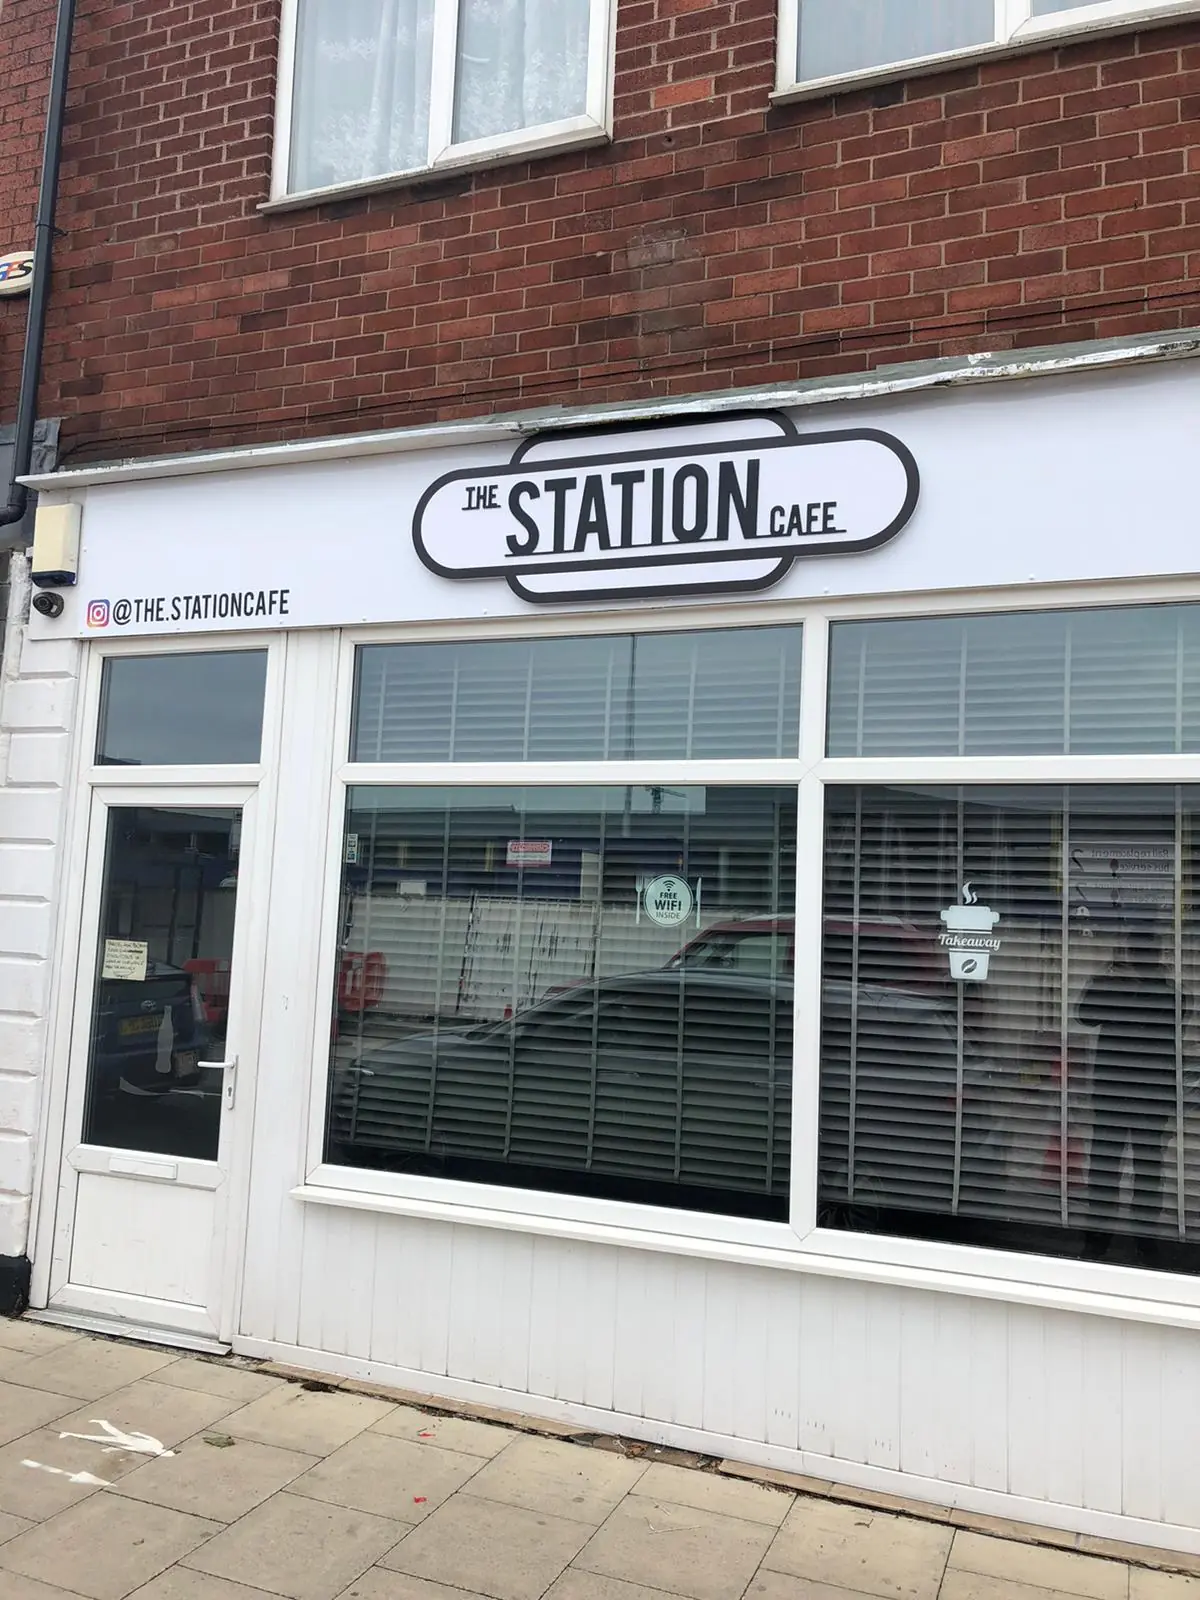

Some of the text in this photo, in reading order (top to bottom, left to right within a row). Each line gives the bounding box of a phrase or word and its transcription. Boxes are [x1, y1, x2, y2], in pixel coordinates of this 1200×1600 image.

[462, 458, 840, 557] THE STATION CAFE
[113, 589, 289, 624] @THE.STATIONCAFE
[660, 892, 678, 900] FREE
[655, 900, 682, 911] WIFI
[938, 934, 1001, 951] Takeaway
